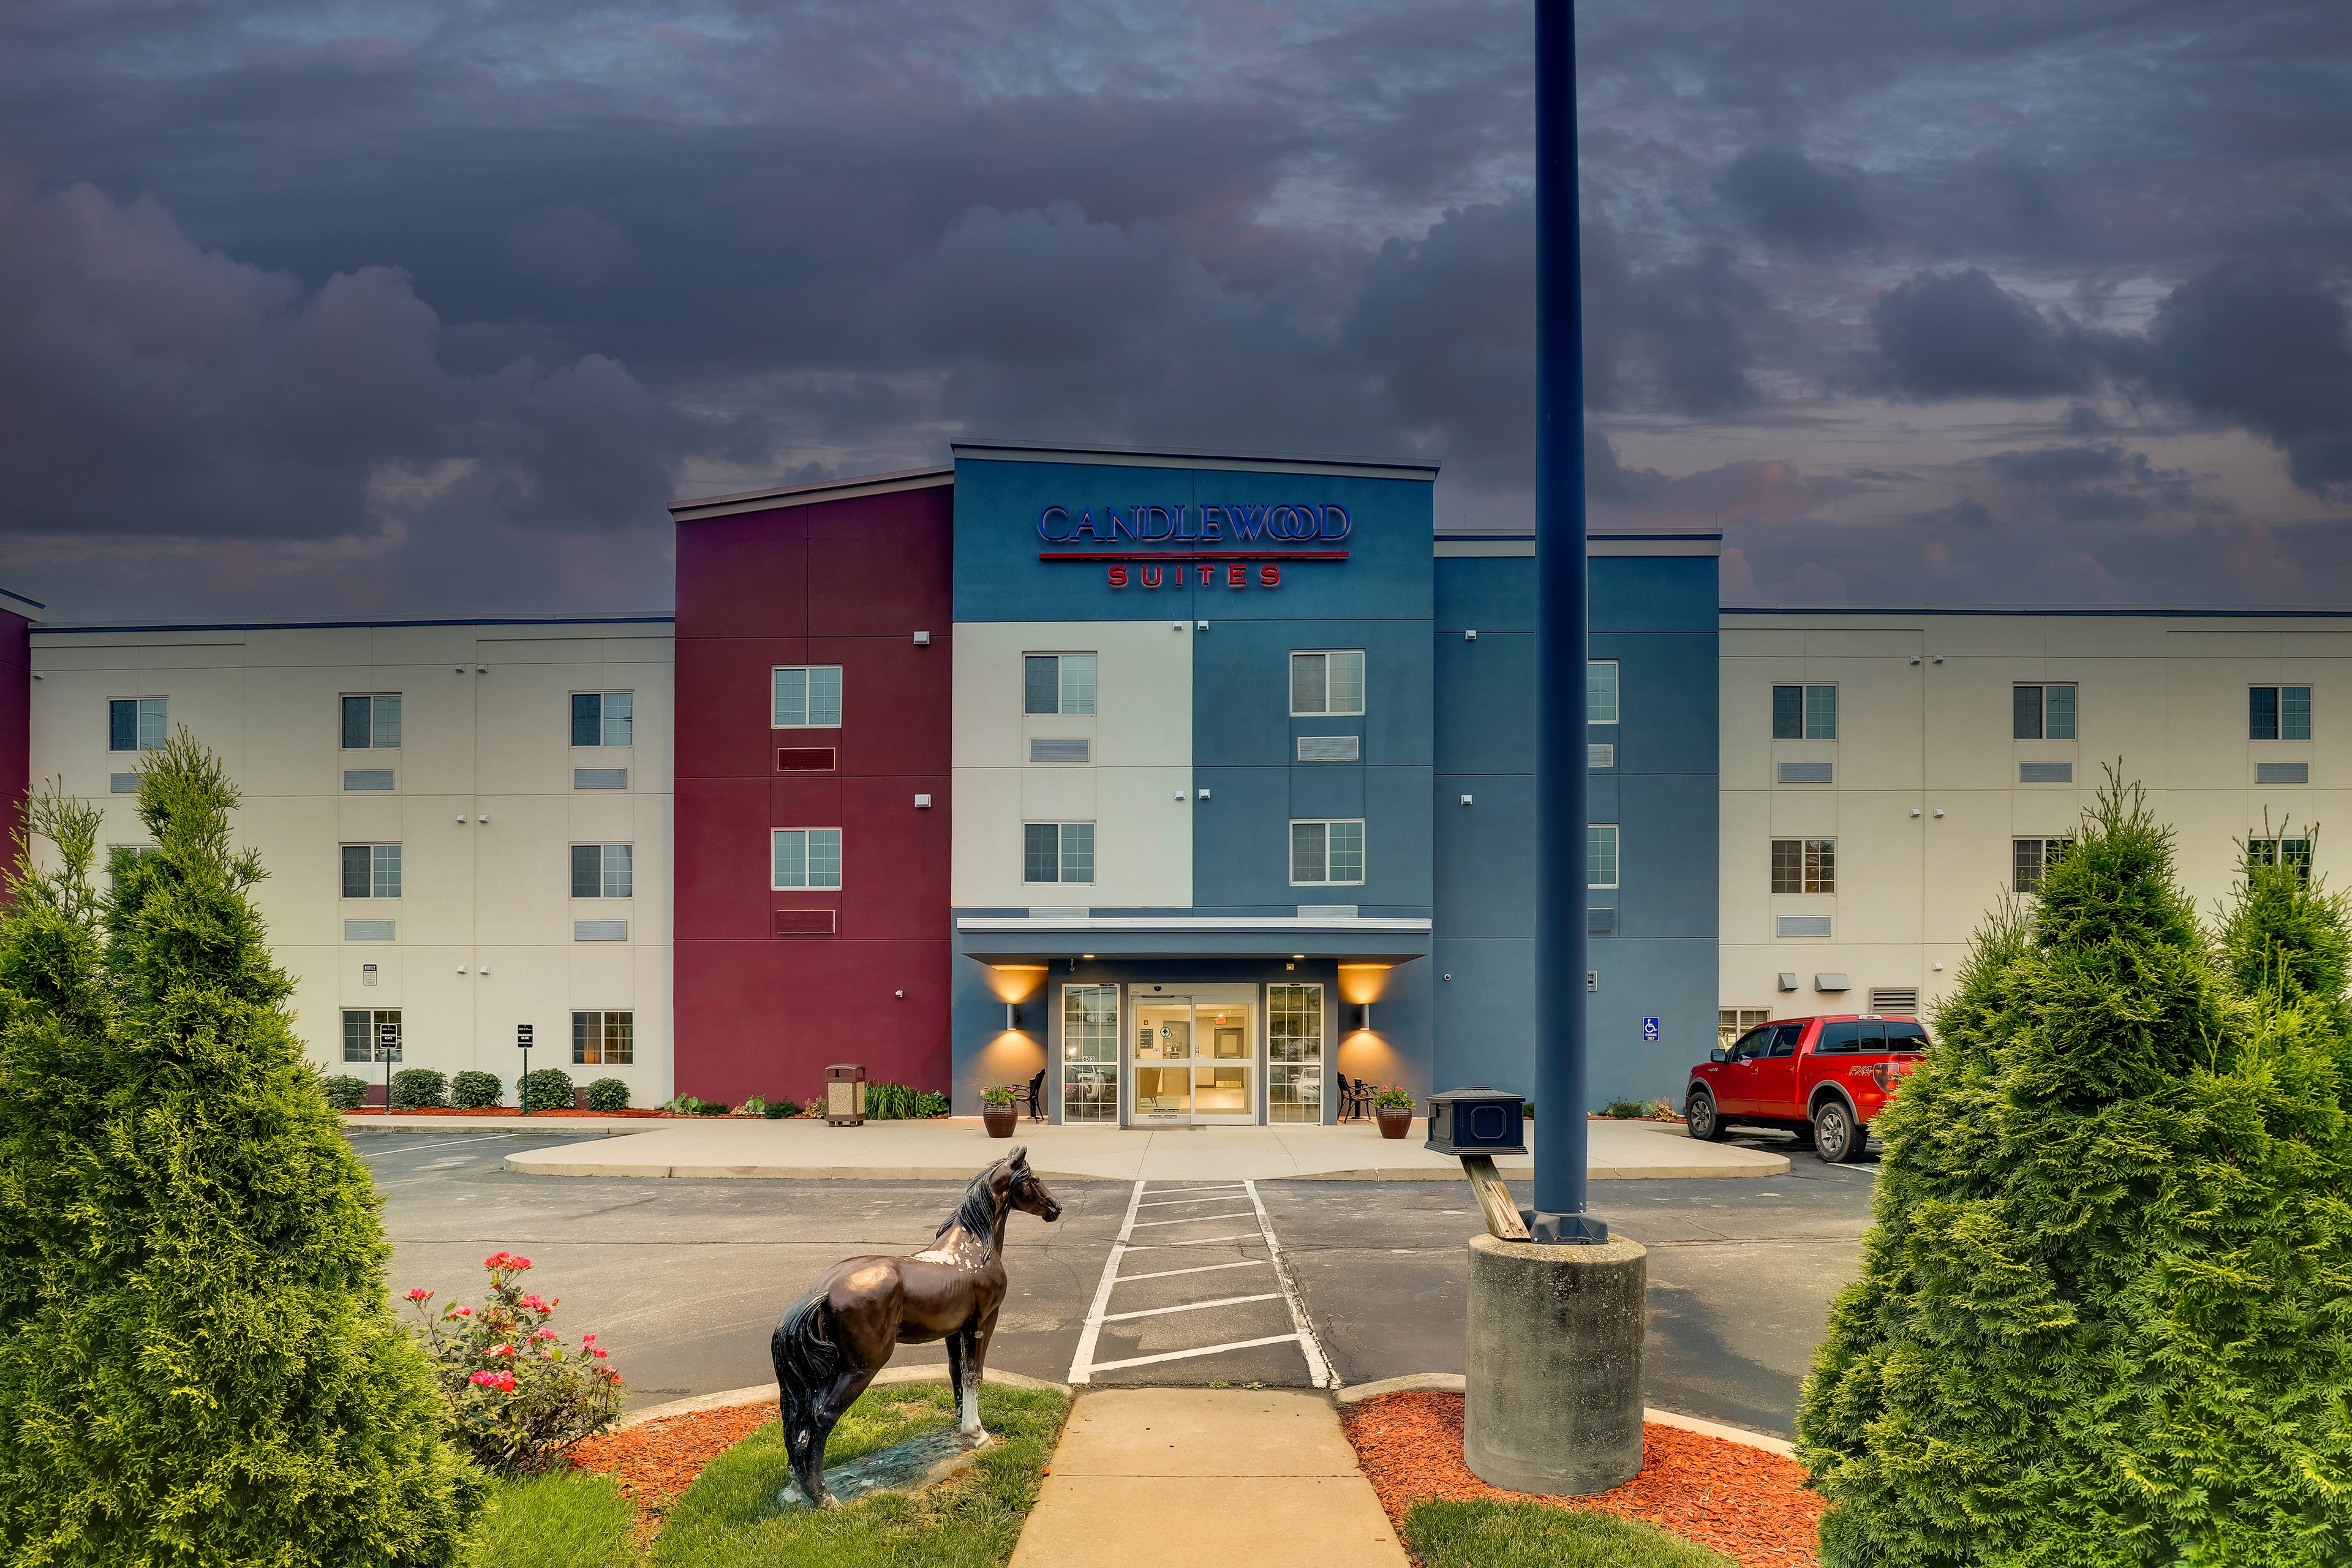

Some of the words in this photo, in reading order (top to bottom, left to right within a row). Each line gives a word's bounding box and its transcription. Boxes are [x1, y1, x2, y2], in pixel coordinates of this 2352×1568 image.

[1038, 504, 1351, 541] CANDLEWOOD
[1108, 564, 1280, 587] SUITES
[1849, 1065, 1872, 1074] FX4
